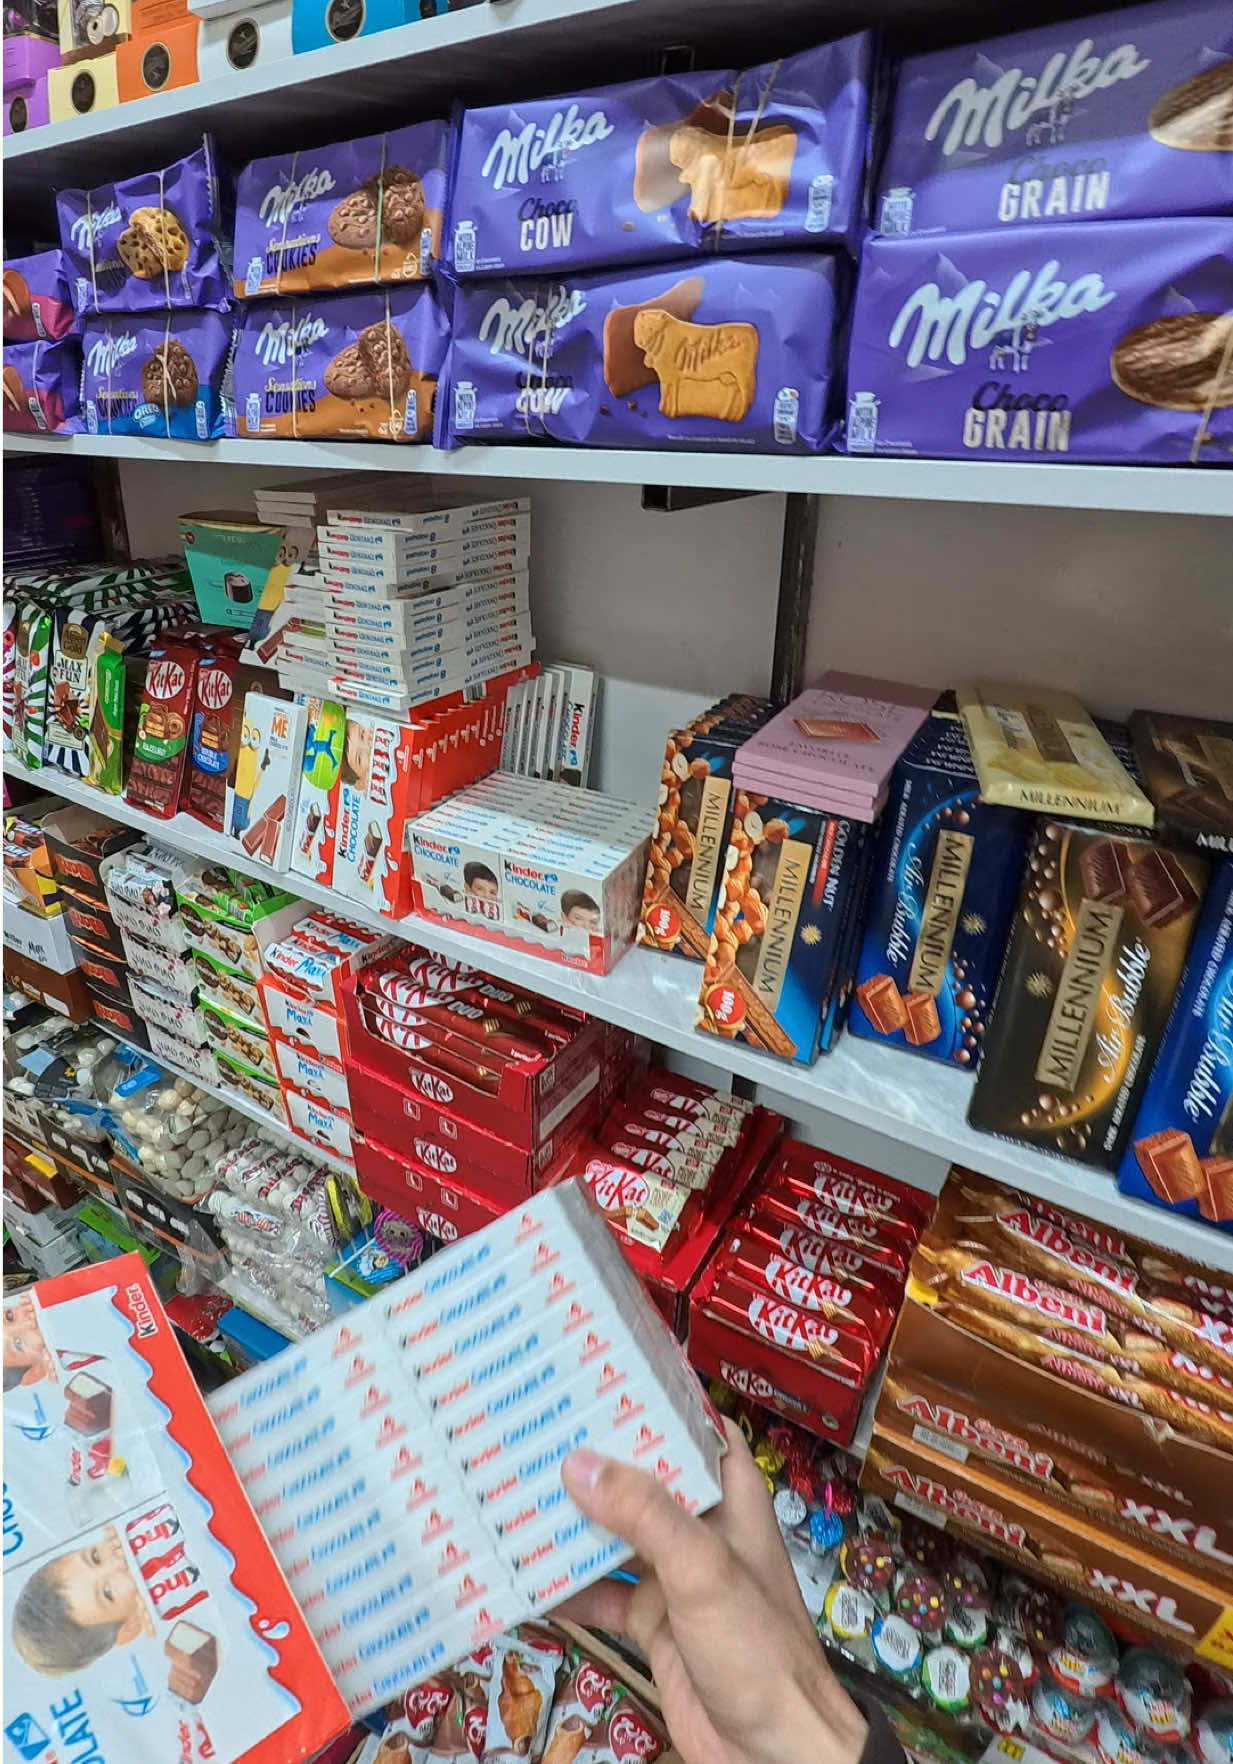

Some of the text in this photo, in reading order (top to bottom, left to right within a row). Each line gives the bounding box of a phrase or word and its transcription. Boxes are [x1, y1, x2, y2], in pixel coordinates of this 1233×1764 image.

[924, 38, 1152, 155] Milka
[481, 103, 614, 190] Milka
[999, 171, 1111, 222] GRAIN
[519, 212, 574, 252] COW
[479, 285, 587, 355] Milka
[889, 259, 1117, 368] Milka
[255, 311, 330, 365] Milka
[972, 381, 1069, 411] Choco
[962, 408, 1072, 452] GRAIN
[58, 657, 83, 673] MAX
[59, 670, 82, 684] FUN
[148, 661, 184, 698] KitKat
[201, 671, 229, 707] KitKat
[568, 702, 585, 749] Kinder
[338, 805, 350, 859] Kinder
[346, 793, 361, 863] CHOCOLATE
[413, 833, 447, 853] Kinder
[414, 844, 460, 868] CHOCOLATE
[504, 859, 543, 882] Kinder
[688, 792, 724, 911] MILLENNIUM
[504, 871, 556, 896] CHOCOLATE
[823, 877, 840, 912] NUT
[758, 857, 801, 994] MILLENNIUM
[915, 837, 965, 990] MILLENNIUM
[270, 949, 328, 980] Kinder Maxi
[286, 1008, 313, 1026] Maxi
[447, 1000, 485, 1020] DUO
[1047, 908, 1113, 1087] MILLENNIUM
[298, 1061, 324, 1079] Maxi
[411, 1071, 451, 1101] KitKat
[308, 1111, 334, 1130] Maxi
[416, 1141, 455, 1172] KitKat
[587, 1169, 647, 1211] KitKat
[818, 1178, 893, 1217] KitKat
[996, 1207, 1140, 1299] Albeni
[771, 1262, 852, 1312] KitKat
[960, 1259, 1107, 1337] Albeni
[126, 1283, 157, 1339] Kinder
[753, 1298, 838, 1351] KitKat
[896, 1395, 1054, 1479] Albeni
[129, 1517, 181, 1557] Kind
[1119, 1498, 1233, 1566] XXL
[147, 1565, 201, 1606] Kind
[1089, 1567, 1196, 1634] XXL
